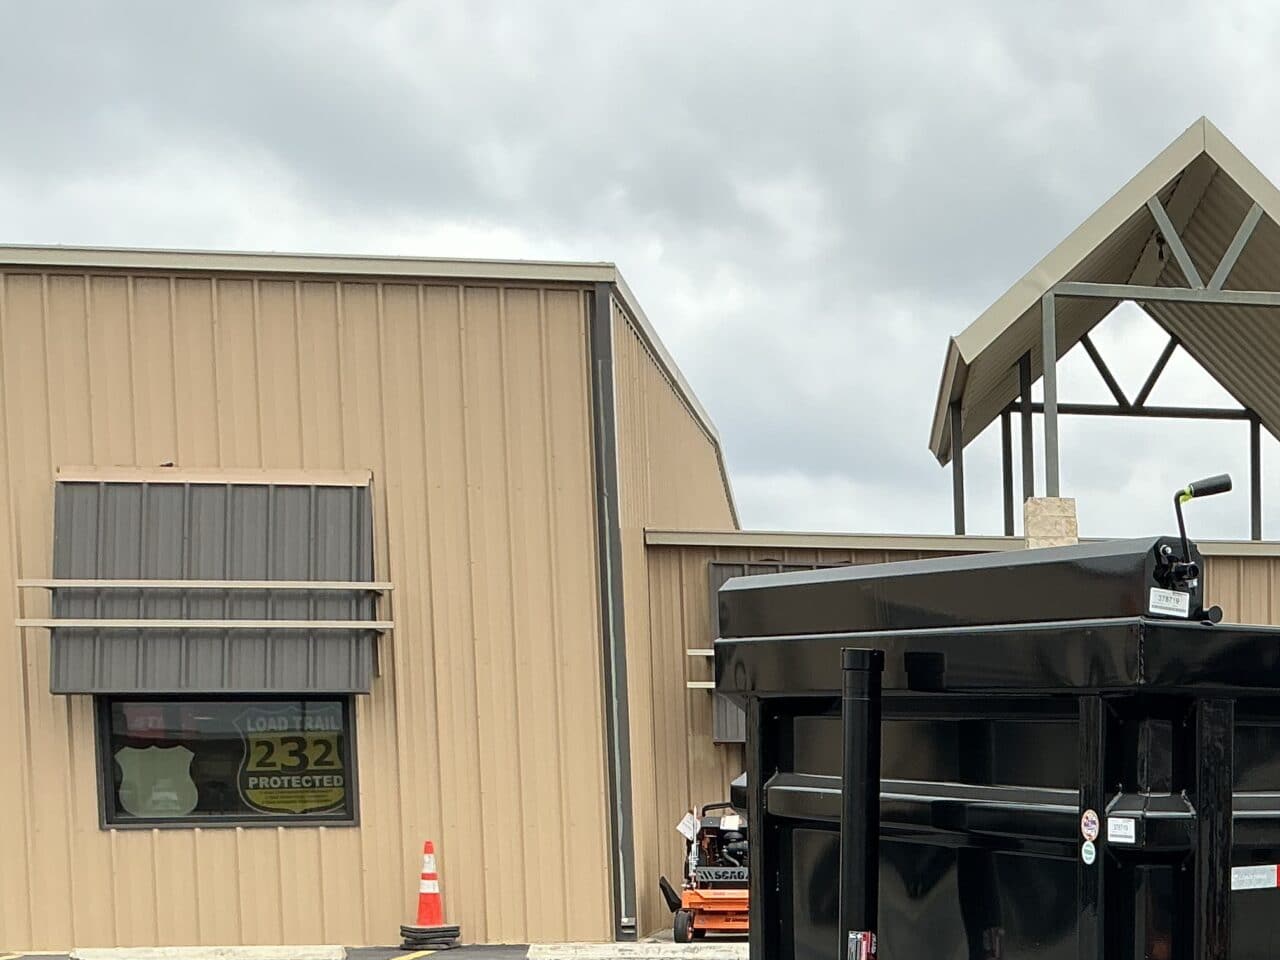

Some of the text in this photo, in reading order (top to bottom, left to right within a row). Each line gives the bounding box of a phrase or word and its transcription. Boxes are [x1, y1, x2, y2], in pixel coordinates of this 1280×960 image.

[247, 715, 340, 731] LOAD TRAIL
[255, 736, 335, 773] 232
[248, 775, 344, 788] PROTECTED
